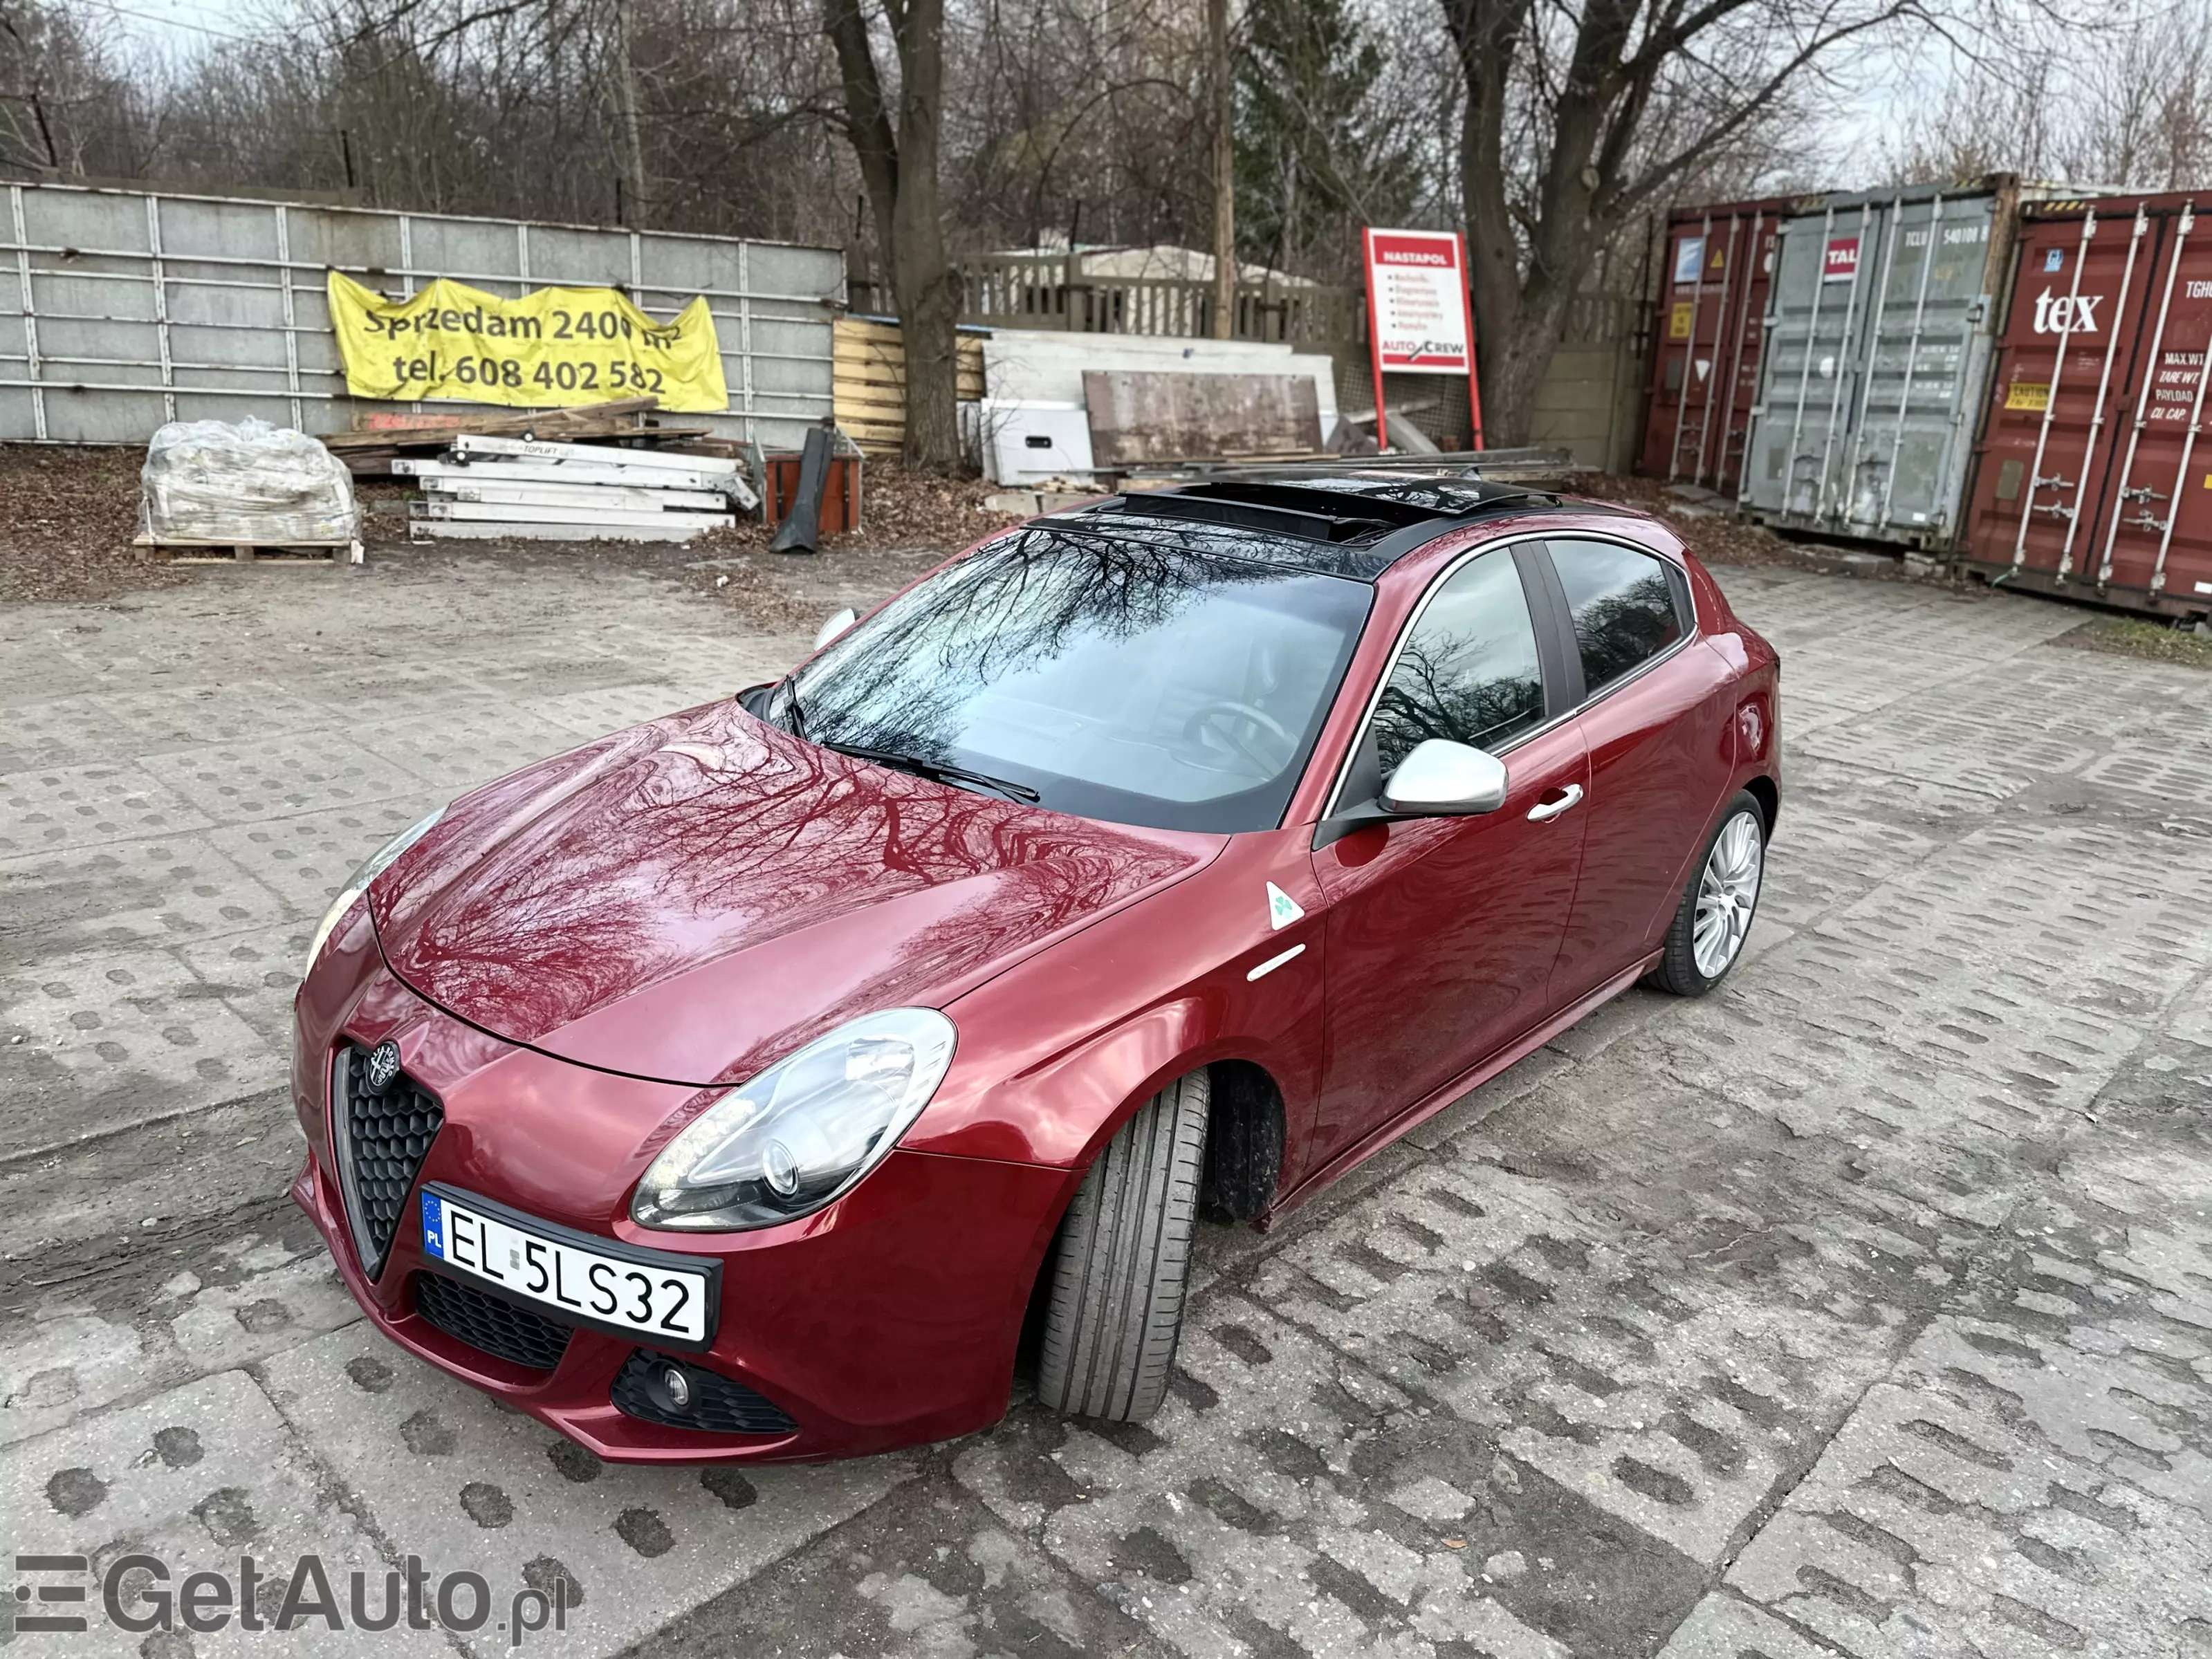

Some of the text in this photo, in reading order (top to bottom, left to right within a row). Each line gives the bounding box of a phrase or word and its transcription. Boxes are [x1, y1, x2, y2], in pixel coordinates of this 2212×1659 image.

[1383, 251, 1447, 265] NASTAPOL
[1828, 248, 1857, 265] TAL
[2034, 285, 2103, 334] tex
[364, 305, 542, 340] Sprzedam
[552, 310, 632, 340] 2400
[1383, 338, 1464, 354] AUTO CREW
[392, 350, 666, 394] tel. 608 402 582
[2159, 370, 2183, 383] TARE
[2156, 389, 2194, 402] PAYLOAD
[2166, 407, 2187, 420] CAP.
[524, 445, 559, 455] TOPLIFT
[427, 1230, 442, 1248] PL
[450, 1209, 690, 1334] EL 5LS32
